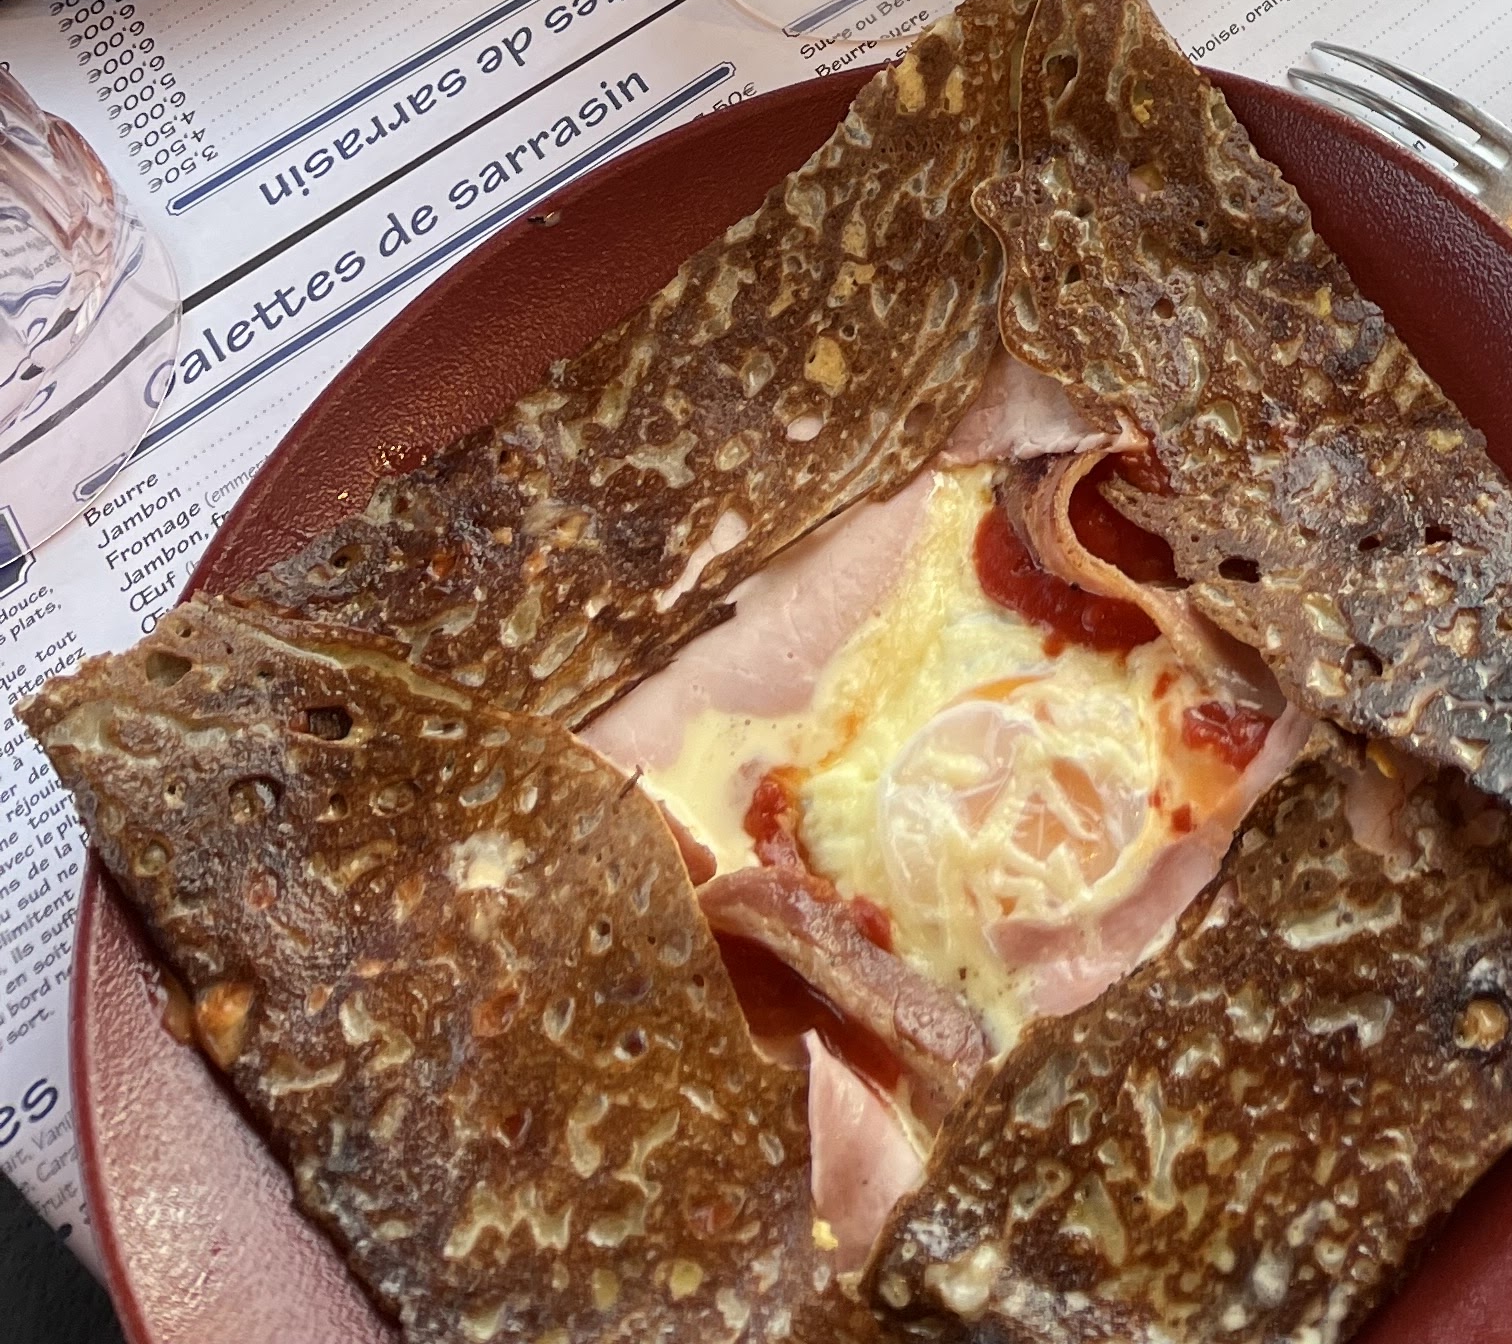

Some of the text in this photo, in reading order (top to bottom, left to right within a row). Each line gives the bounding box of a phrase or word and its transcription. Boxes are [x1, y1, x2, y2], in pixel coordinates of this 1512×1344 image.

[67, 4, 135, 49] 6,00€
[77, 21, 144, 66] 6,00€
[855, 12, 878, 33] ou
[87, 37, 155, 84] 6,00€
[97, 55, 165, 102] 6,00€
[107, 73, 176, 120] 5,00€
[117, 91, 186, 138] 6,00€
[258, 66, 468, 207] sarrasin
[476, 24, 534, 69] de
[128, 111, 195, 156] 4,50€
[138, 128, 206, 175] 4,50€
[148, 144, 218, 193] 3,50€
[377, 201, 440, 257] de
[449, 66, 651, 218] sarrasin
[83, 473, 159, 527] Beurre
[97, 487, 182, 549] Jambon
[105, 502, 201, 570] Fromage
[120, 529, 209, 592] Jambon,
[129, 571, 176, 613] Œuf
[9, 603, 63, 642] plats,
[35, 630, 78, 663] tout
[7, 646, 87, 706] attendez
[18, 862, 78, 911] sud ne
[7, 978, 51, 1018] bord
